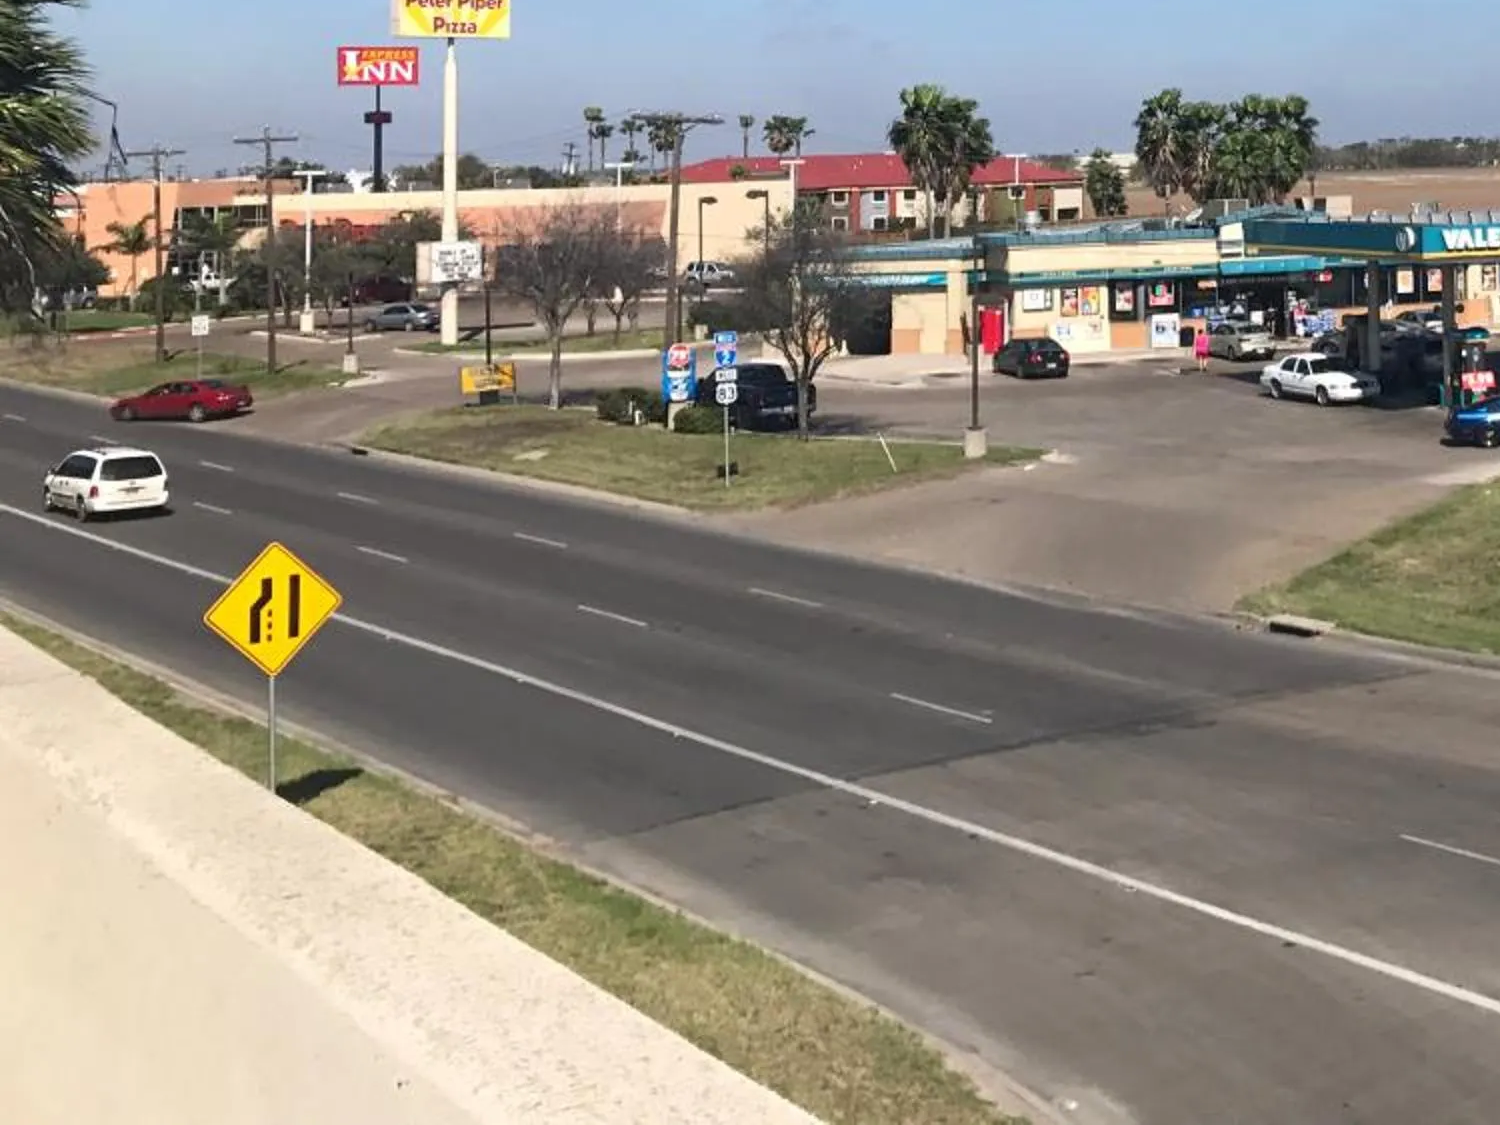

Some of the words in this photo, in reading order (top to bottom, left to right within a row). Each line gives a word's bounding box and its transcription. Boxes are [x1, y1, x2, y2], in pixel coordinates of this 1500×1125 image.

[433, 17, 477, 34] Pizza
[361, 50, 417, 61] EXPRESS
[343, 51, 416, 82] INN
[719, 386, 735, 401] 83
